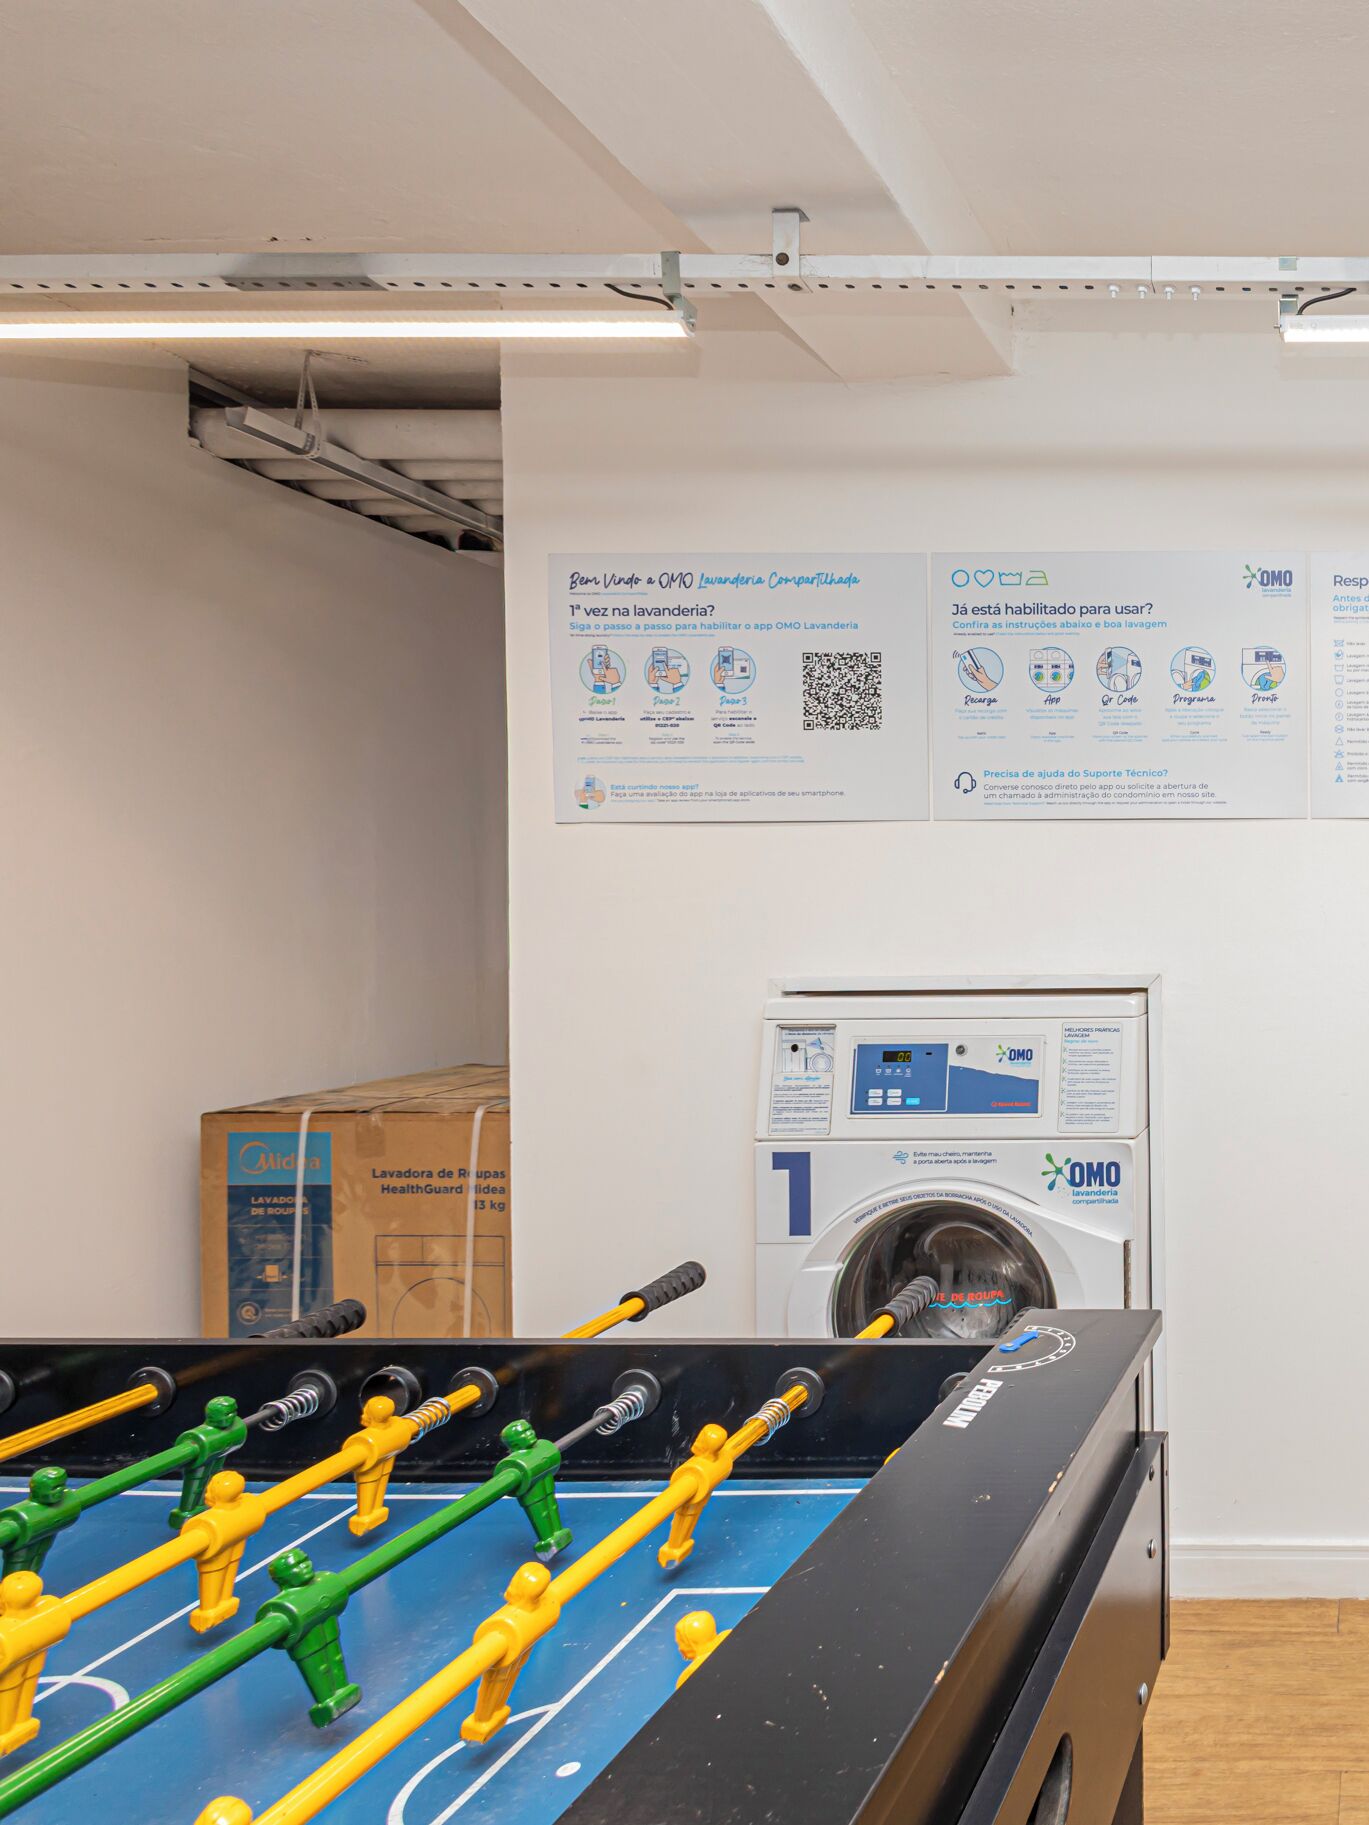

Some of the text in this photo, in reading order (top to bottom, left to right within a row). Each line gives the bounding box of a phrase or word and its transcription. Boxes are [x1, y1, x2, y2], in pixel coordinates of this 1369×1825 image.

[569, 571, 860, 590] Bem Vindo a OMO Lavanderia Compartilhada
[1261, 570, 1293, 586] OMO
[1333, 594, 1361, 602] Antes
[570, 604, 715, 616] 1ª vez na lavanderia?
[952, 603, 1153, 618] Já está habilitado para usar?
[569, 621, 591, 632] Siga
[603, 623, 632, 632] passo
[644, 623, 672, 632] passo
[675, 623, 697, 632] para
[700, 621, 741, 630] habilitar
[753, 623, 773, 632] app
[775, 621, 801, 630] OMO
[803, 621, 859, 630] Lavanderia
[952, 620, 989, 629] Confira
[1005, 620, 1057, 631] instruções
[1060, 620, 1092, 629] abaixo
[1103, 620, 1122, 629] boa
[1125, 619, 1167, 631] lavagem
[964, 695, 998, 706] Recarga
[1044, 695, 1061, 705] App
[1101, 695, 1139, 706] Qr Code
[1173, 693, 1215, 705] Programa
[1251, 693, 1279, 704] Pronto
[983, 768, 1168, 780] Precisa de ajuda do Suporte Técnico?
[1079, 783, 1097, 792] pelo
[1044, 792, 1100, 800] administração
[1009, 1048, 1033, 1061] OMO
[953, 1158, 967, 1166] após
[372, 1168, 506, 1180] Lavadora de Rupas
[1069, 1161, 1121, 1187] OMO
[381, 1184, 463, 1194] HealthGuard
[772, 1151, 811, 1236] 1
[251, 1196, 309, 1204] LAVADOA
[474, 1200, 506, 1212] 13 kg
[250, 1207, 309, 1215] DE ROUPS
[942, 1378, 1003, 1429] PEBOLIM
